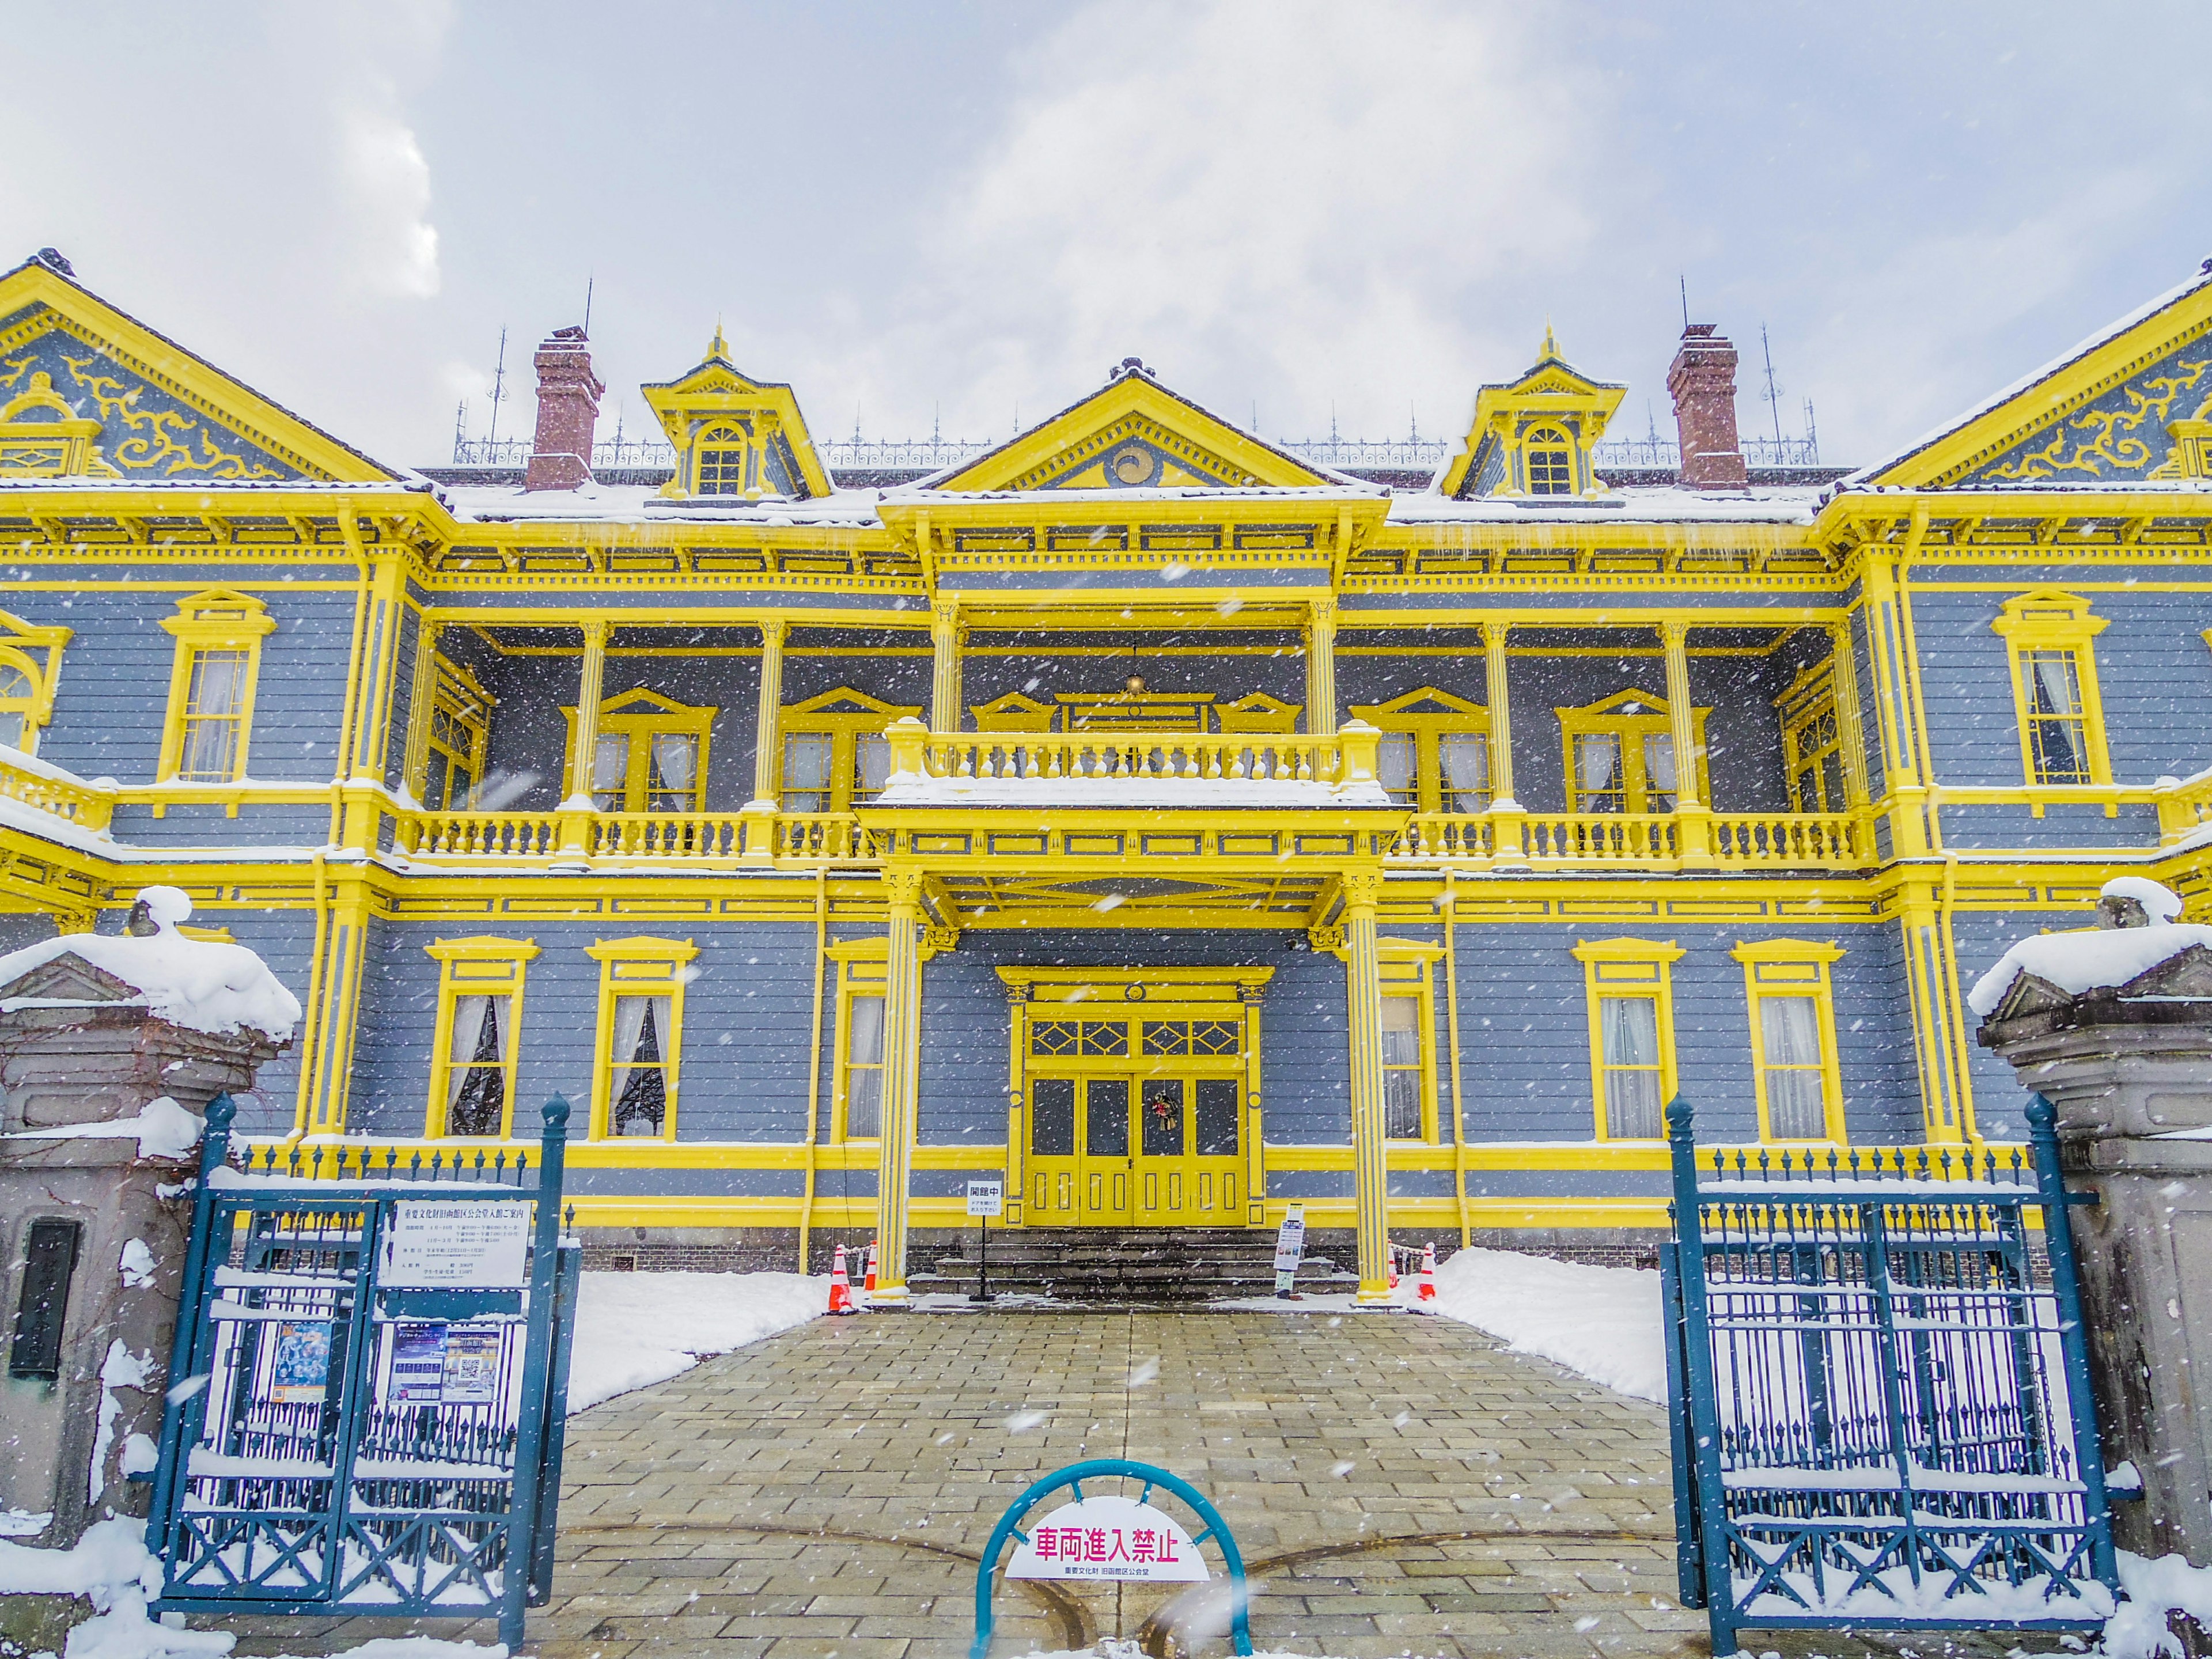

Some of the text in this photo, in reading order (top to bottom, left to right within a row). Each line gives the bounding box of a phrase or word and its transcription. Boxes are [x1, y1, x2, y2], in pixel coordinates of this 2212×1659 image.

[970, 1187, 999, 1196] 開館中
[405, 1209, 524, 1219] 重要文化財旧函館区公会堂入館ご案内
[1035, 1527, 1179, 1563] 車両進入禁止
[1065, 1567, 1149, 1576] 重要文化財 旧函館区公会堂
